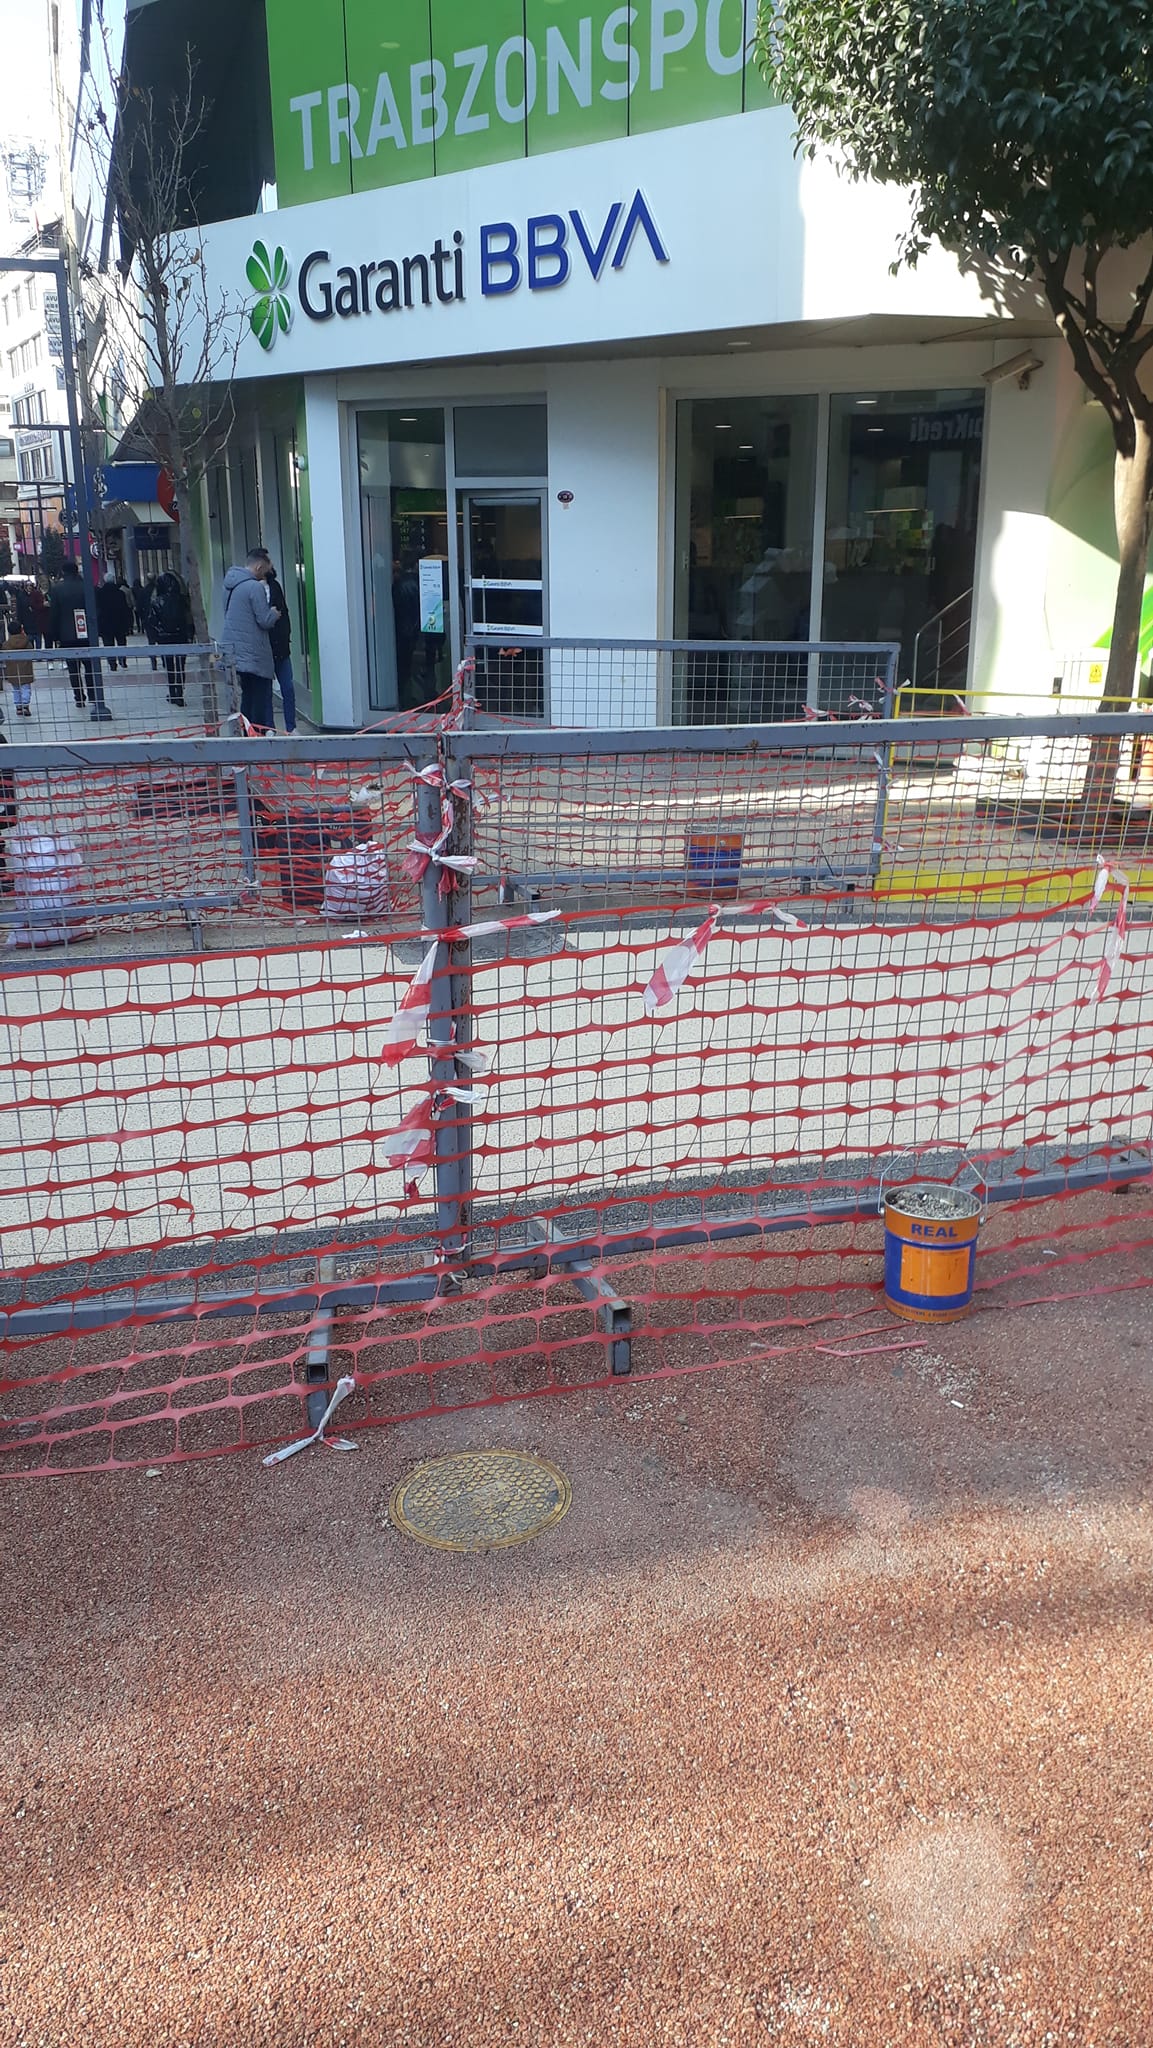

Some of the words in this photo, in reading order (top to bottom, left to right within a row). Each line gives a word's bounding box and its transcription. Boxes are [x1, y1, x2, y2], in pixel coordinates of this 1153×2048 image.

[299, 230, 465, 322] Garanti
[480, 188, 669, 297] BBVA
[911, 1223, 958, 1238] REAL
